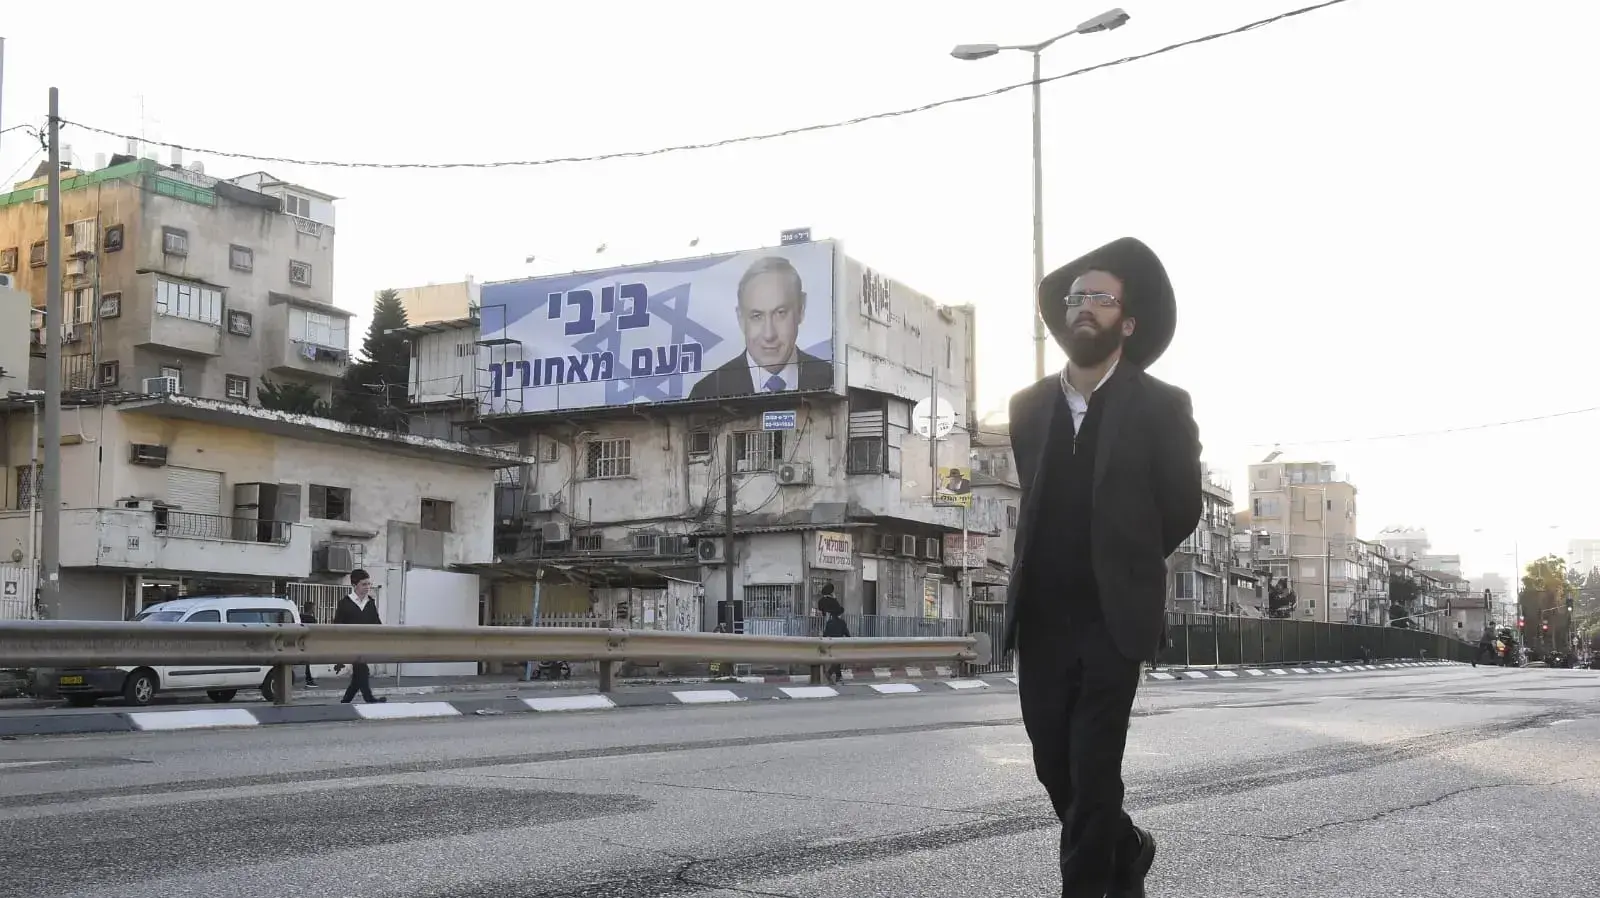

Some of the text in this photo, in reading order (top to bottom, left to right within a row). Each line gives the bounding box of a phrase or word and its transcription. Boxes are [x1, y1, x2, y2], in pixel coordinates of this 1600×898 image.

[547, 283, 650, 336] ביבי
[489, 342, 704, 398] העם מאחוריך
[824, 536, 849, 553] חשמלאי
